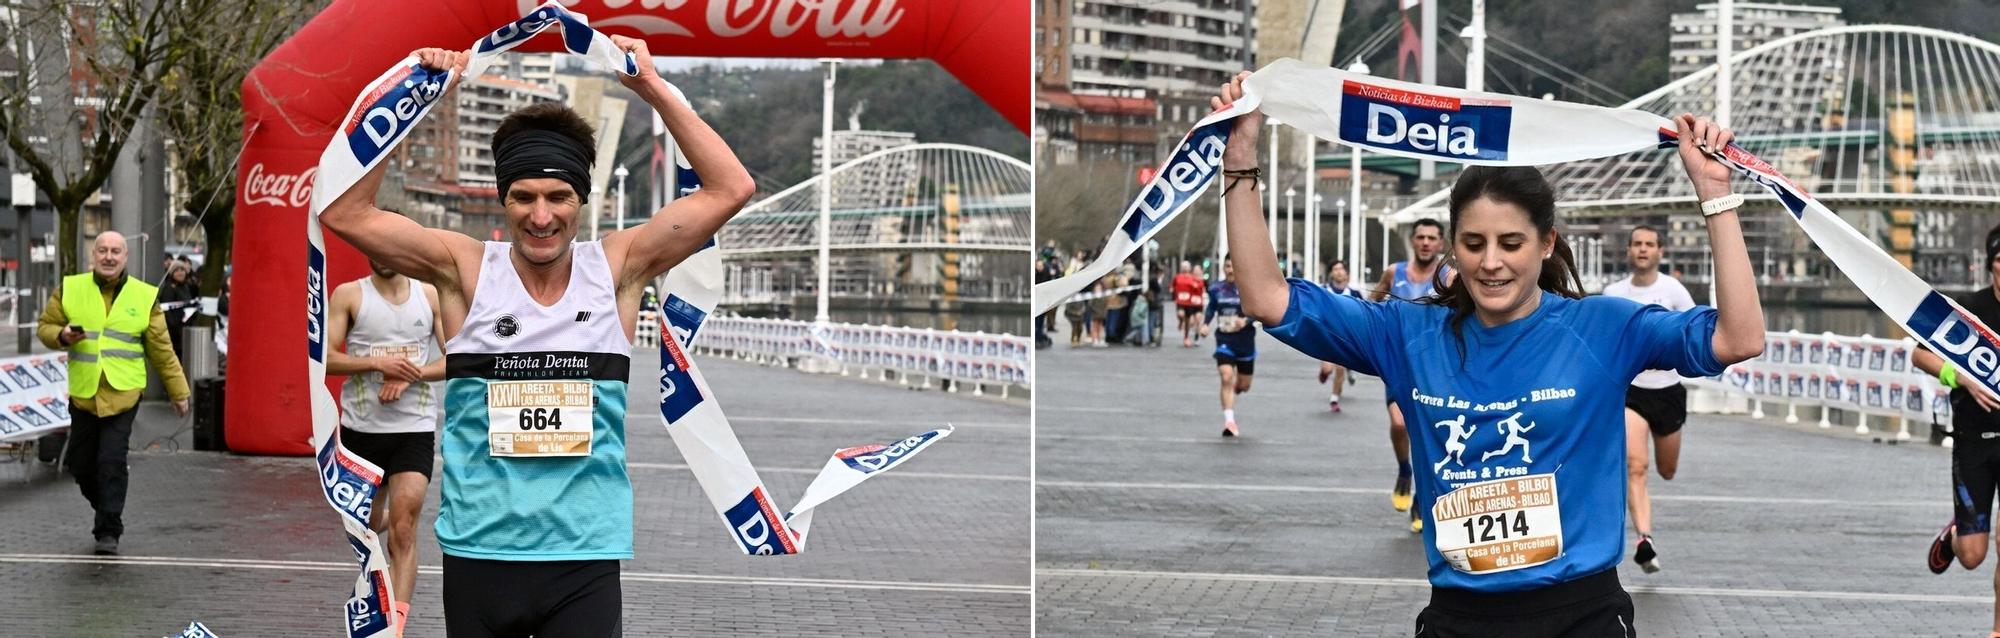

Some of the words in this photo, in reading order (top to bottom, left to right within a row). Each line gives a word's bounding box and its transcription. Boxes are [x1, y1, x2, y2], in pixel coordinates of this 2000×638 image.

[1358, 85, 1397, 101] Noticias
[1399, 93, 1411, 103] de
[1413, 95, 1453, 109] Bizkaia
[362, 80, 441, 149] Deia
[1366, 103, 1478, 156] Deia
[1139, 135, 1227, 221] Deia
[494, 355, 540, 369] Peñota
[544, 354, 589, 369] Dental
[492, 384, 520, 407] XXVII
[521, 383, 555, 394] AREETA
[563, 383, 588, 394] BILBO
[1412, 387, 1444, 407] Crrera
[1447, 396, 1470, 409] Las
[1531, 387, 1576, 402] Bilbao
[519, 407, 562, 431] 664
[538, 443, 549, 452] de
[1442, 469, 1477, 480] Events
[1481, 467, 1491, 478] &
[1495, 466, 1528, 478] Press
[323, 451, 373, 523] Deia
[1470, 483, 1508, 500] AREETA
[1518, 478, 1549, 492] BILBO
[1438, 489, 1470, 520] XXVII
[1470, 501, 1485, 513] LAS
[1486, 497, 1517, 511] ARENAS
[1522, 492, 1550, 506] BILBAO
[738, 510, 773, 555] De
[1463, 510, 1530, 544] 1214
[1467, 548, 1488, 558] Casa
[1490, 545, 1500, 554] de
[1502, 543, 1511, 553] la
[1513, 538, 1556, 551] Porcelana
[1496, 555, 1509, 567] de
[1511, 554, 1526, 565] Lis
